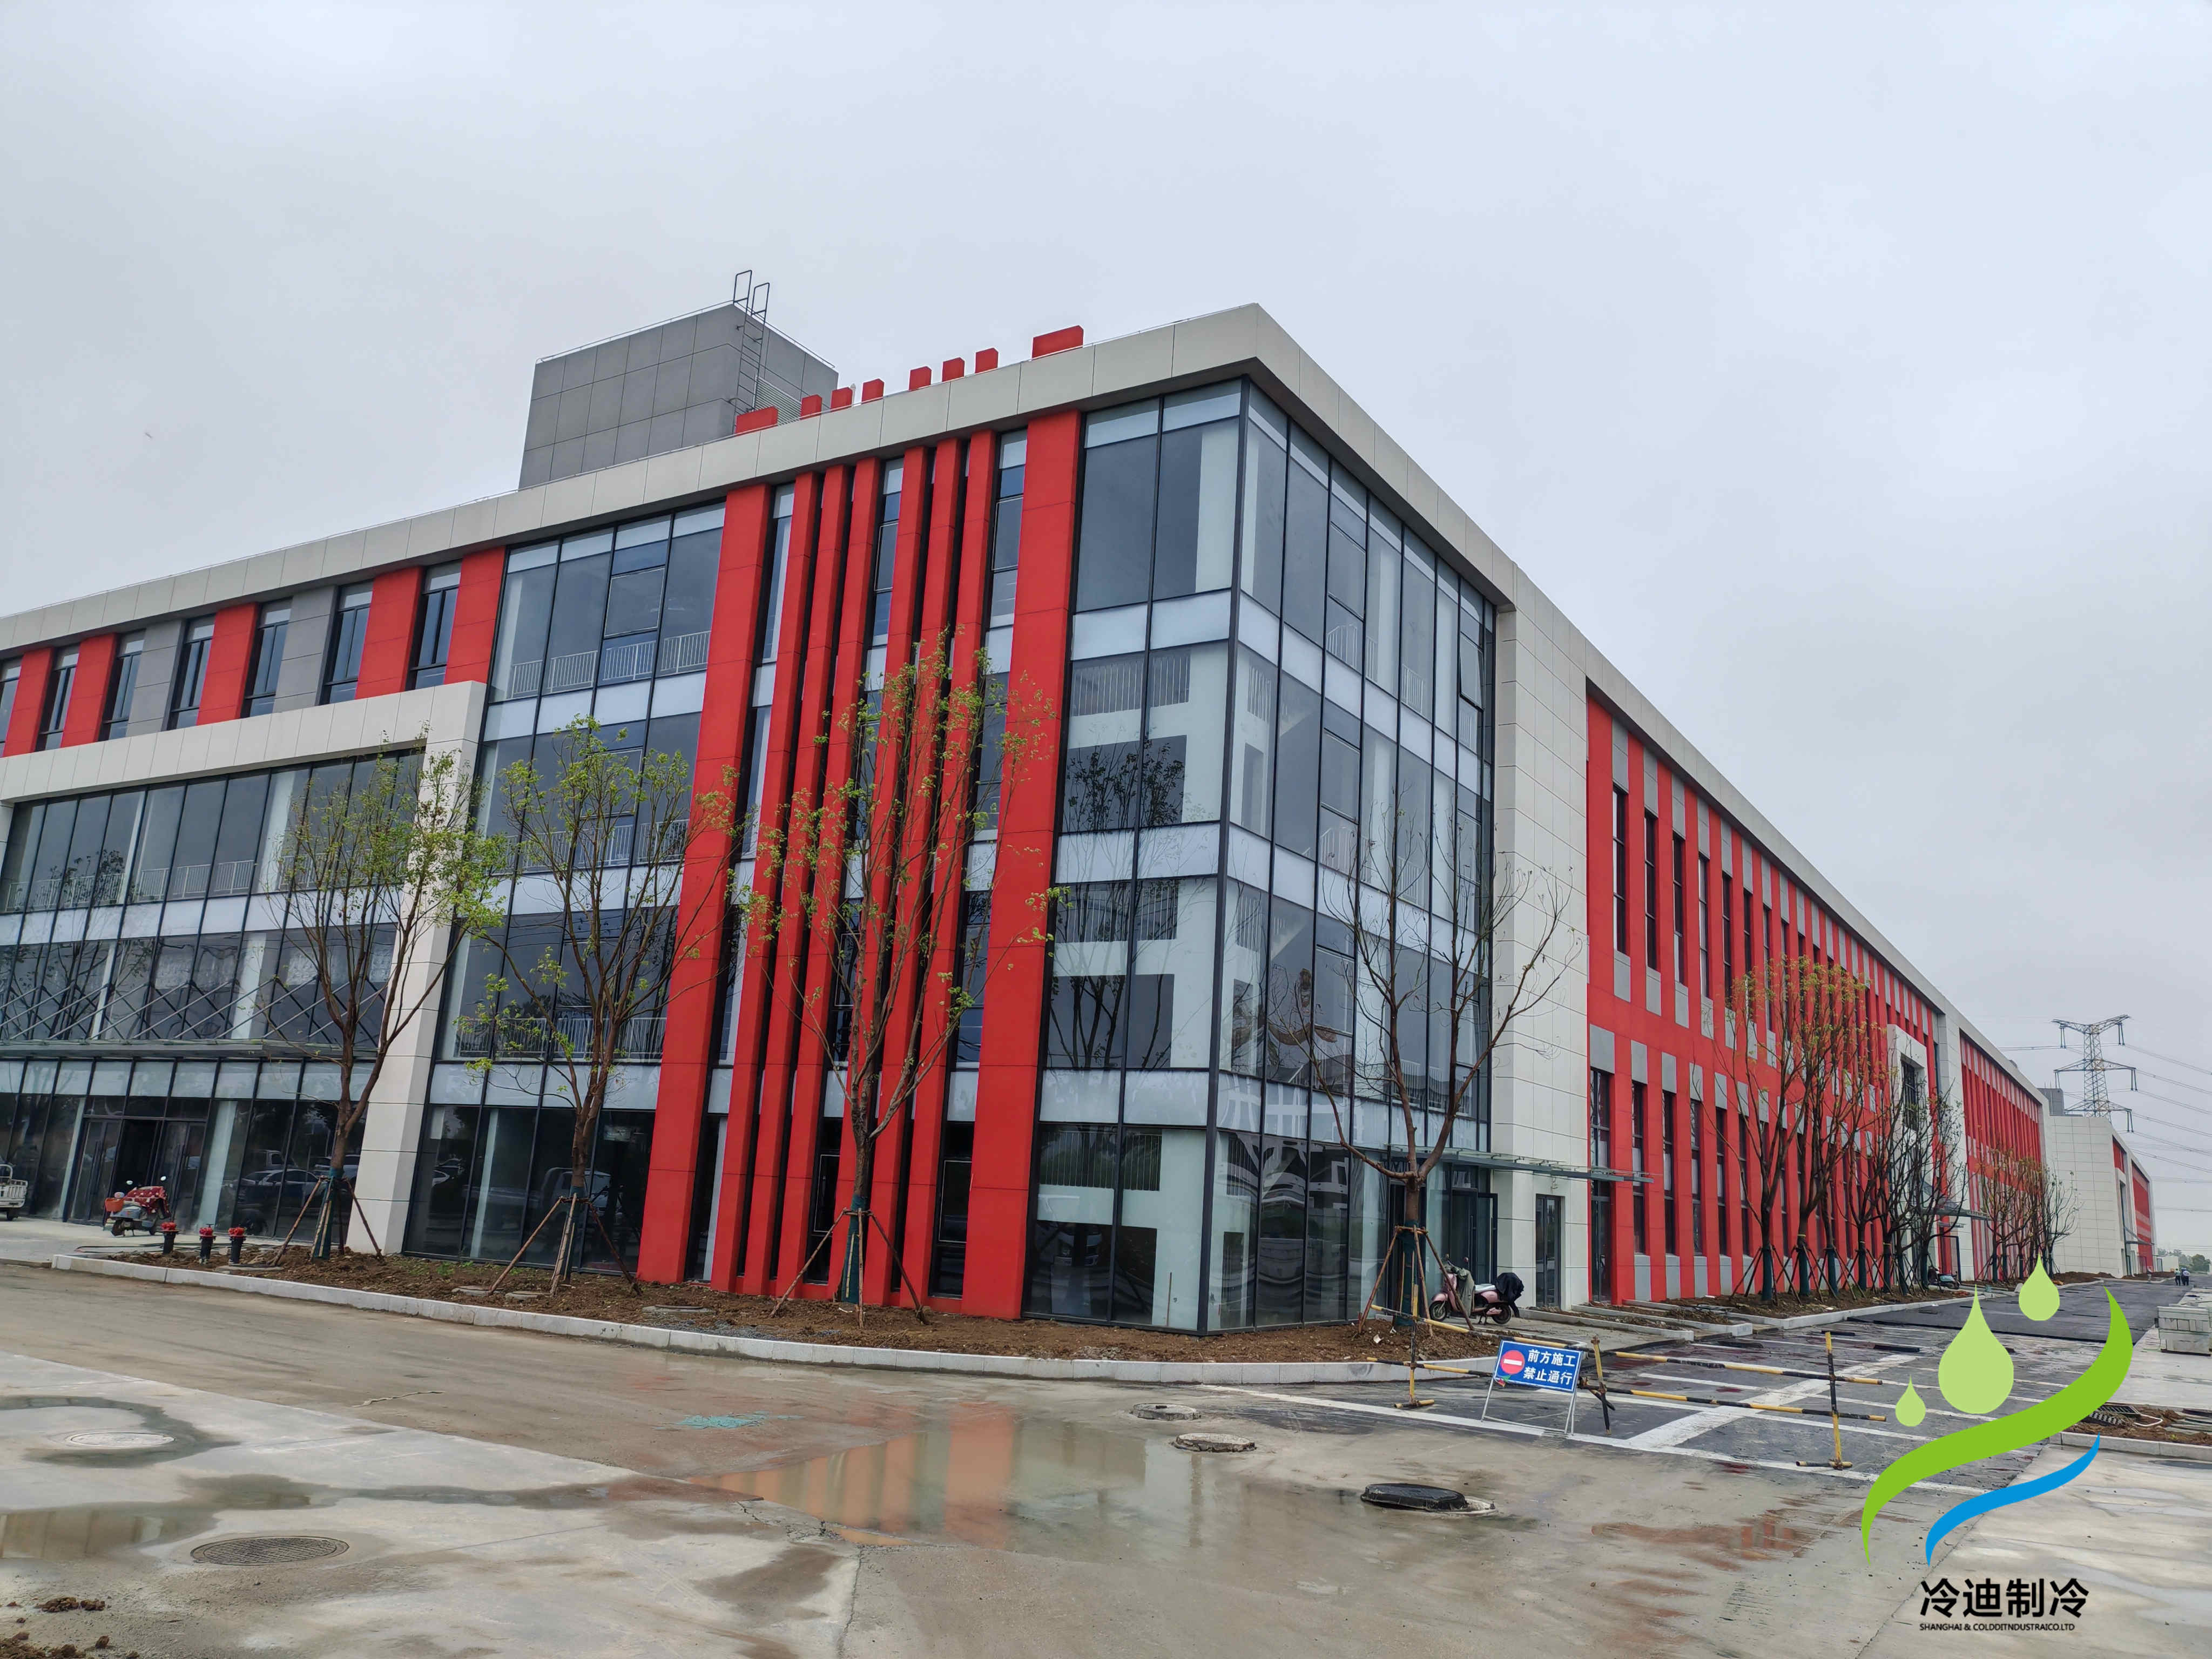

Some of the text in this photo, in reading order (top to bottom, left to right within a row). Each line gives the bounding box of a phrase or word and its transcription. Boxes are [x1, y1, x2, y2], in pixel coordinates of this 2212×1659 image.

[1528, 1350, 1576, 1367] 前方施工
[1523, 1366, 1573, 1385] 禁止通行
